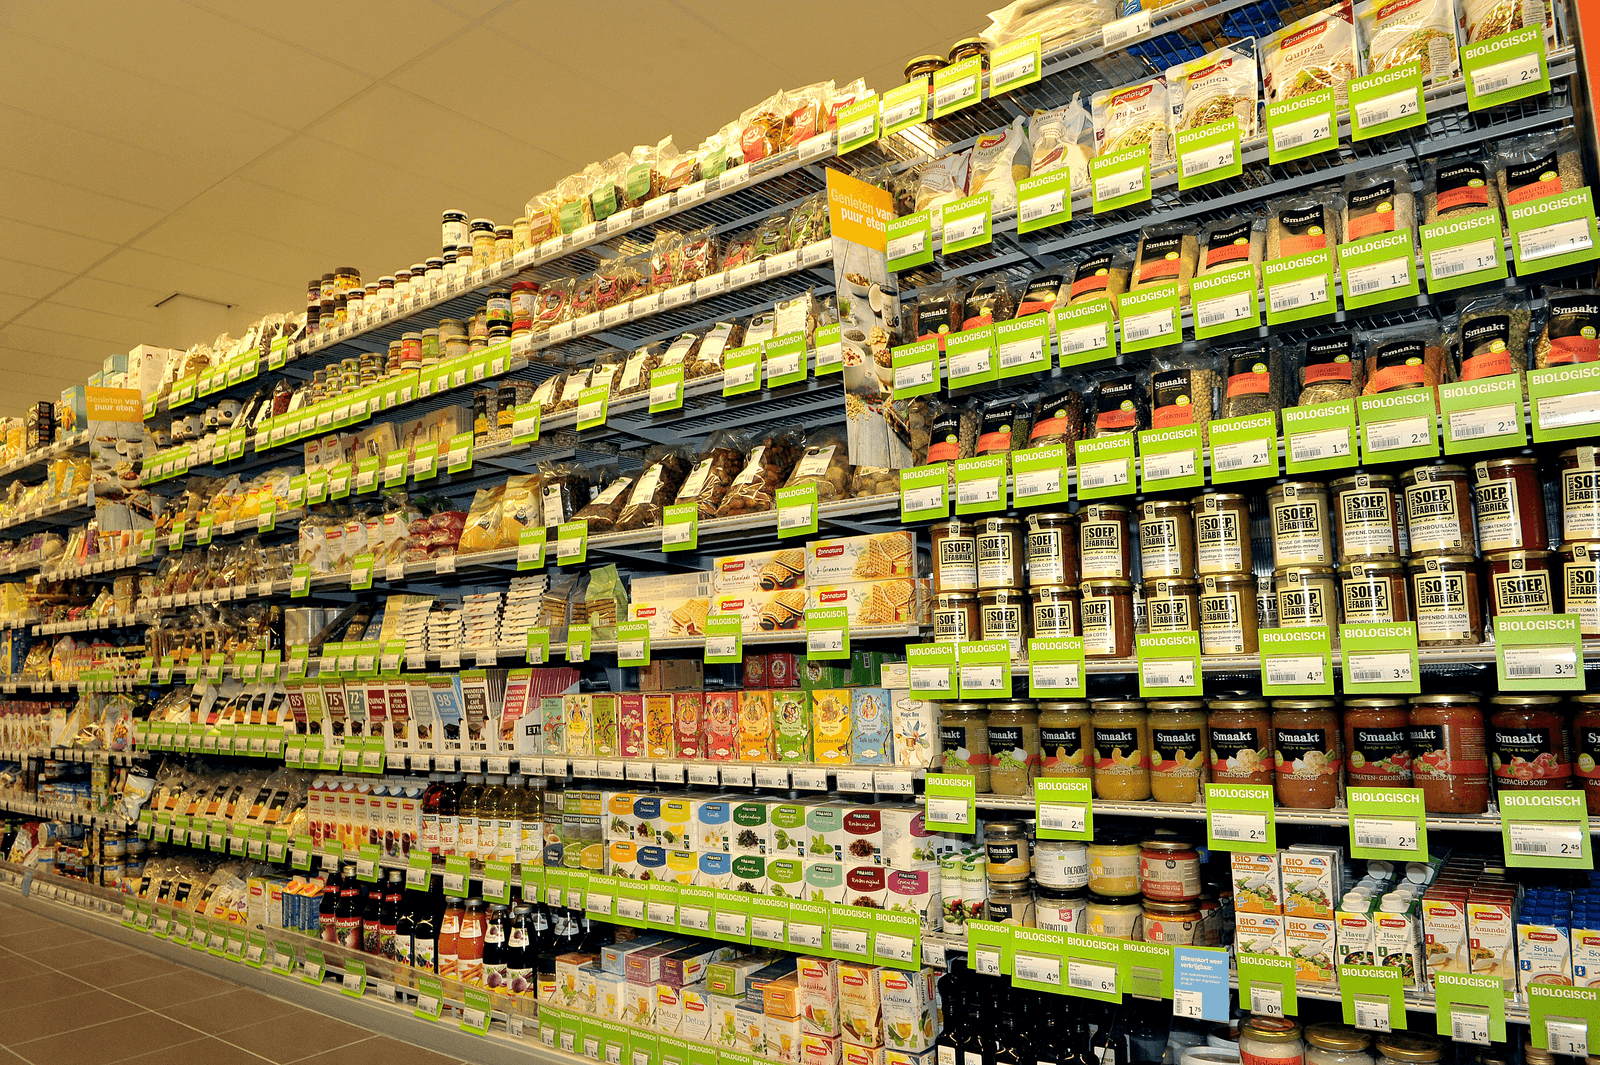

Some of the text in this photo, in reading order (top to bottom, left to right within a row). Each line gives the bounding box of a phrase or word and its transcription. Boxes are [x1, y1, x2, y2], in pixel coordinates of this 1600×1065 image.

[993, 36, 1038, 59] BIOLOGISCH
[1465, 30, 1538, 59] BIOLOGISCH
[936, 59, 979, 80] BIOLOGISCH
[1521, 67, 1539, 81] 2.69
[1351, 66, 1417, 93] BIOLOGISCH
[1270, 92, 1331, 117] BIOLOGISCH
[1400, 101, 1416, 114] 2.69
[1179, 122, 1235, 144] BIOLOGISCH
[1313, 127, 1328, 138] 2.69
[1094, 148, 1146, 170] BIOLOGISCH
[1440, 166, 1481, 179] Smaakt
[1020, 171, 1068, 191] BIOLOGISCH
[830, 188, 893, 221] Genieten van
[945, 196, 988, 214] BIOLOGISCH
[1512, 193, 1588, 220] BIOLOGISCH
[841, 208, 863, 224] puur
[1282, 211, 1320, 224] Smaakt
[888, 214, 928, 231] BIOLOGISCH
[1424, 214, 1495, 239] BIOLOGISCH
[1341, 234, 1407, 257] BIOLOGISCH
[1266, 253, 1328, 274] BIOLOGISCH
[1476, 254, 1494, 268] 1.59
[1029, 279, 1058, 290] Smaakt
[1193, 270, 1251, 291] BIOLOGISCH
[1121, 288, 1175, 306] BIOLOGISCH
[920, 308, 948, 318] Smaakt
[1058, 304, 1107, 320] BIOLOGISCH
[1552, 305, 1598, 316] Smaakt
[998, 317, 1045, 334] BIOLOGISCH
[1464, 323, 1505, 339] Smaakt
[767, 335, 803, 349] BIOLOGISCH
[1310, 341, 1348, 351] Smaakt
[727, 347, 759, 360] BIOLOGISCH
[894, 342, 935, 358] BIOLOGISCH
[1155, 377, 1188, 389] Smaakt
[1444, 380, 1516, 399] BIOLOGISCH
[1361, 392, 1430, 410] BIOLOGISCH
[1286, 405, 1350, 421] BIOLOGISCH
[1212, 417, 1271, 433] BIOLOGISCH
[1497, 420, 1515, 432] 2.19
[1142, 428, 1197, 443] BIOLOGISCH
[1078, 438, 1130, 453] BIOLOGISCH
[1015, 449, 1063, 462] BIOLOGISCH
[902, 467, 945, 481] BIOLOGISCH
[778, 487, 814, 499] BIOLOGISCH
[1415, 489, 1446, 503] SOEP
[1352, 494, 1382, 508] SOEP
[1283, 507, 1312, 520] SOEP
[1353, 506, 1386, 519] FABRIEK
[1416, 501, 1449, 515] FABRIEK
[1284, 520, 1314, 530] FABRIEK
[1425, 578, 1458, 593] SOEP
[1507, 577, 1541, 591] SOEP
[1426, 594, 1459, 605] FABRIEK
[1508, 592, 1545, 603] FABRIEK
[808, 611, 845, 620] BIOLOGISCH
[1499, 620, 1575, 631] BIOLOGISCH
[1263, 632, 1326, 642] BIOLOGISCH
[1344, 628, 1412, 638] BIOLOGISCH
[1032, 642, 1081, 650] BIOLOGISCH
[1140, 636, 1196, 647] BIOLOGISCH
[909, 647, 952, 656] BIOLOGISCH
[961, 644, 1007, 653] BIOLOGISCH
[1394, 669, 1409, 678] 3.65
[1555, 664, 1573, 674] 3.59
[1042, 731, 1076, 739] Smaakt
[1096, 731, 1132, 742] Smaakt
[1157, 733, 1196, 742] Smaakt
[1213, 731, 1252, 740] Smaakt
[1278, 732, 1320, 742] Smaakt
[1359, 731, 1404, 742] Smaakt
[1496, 733, 1542, 744] Smaakt
[928, 778, 972, 787] BIOLOGISCH
[1038, 782, 1088, 791] BIOLOGISCH
[1209, 789, 1269, 799] BIOLOGISCH
[1352, 793, 1420, 803] BIOLOGISCH
[1504, 796, 1581, 806] BIOLOGISCH
[1561, 844, 1579, 854] 2.45
[1286, 858, 1303, 866] BIO
[1284, 866, 1304, 874] Avena
[681, 888, 714, 898] BIOLOGISCH
[717, 892, 749, 903] BIOLOGISCH
[832, 908, 871, 919] BIOLOGISCH
[876, 914, 917, 925] BIOLOGISCH
[970, 922, 1009, 934] BIOLOGISCH
[1473, 926, 1507, 934] Amandel
[1015, 931, 1063, 944] BIOLOGISCH
[1068, 937, 1118, 952] BIOLOGISCH
[1124, 944, 1170, 955] BIOLOGISCH
[1534, 945, 1553, 954] Soja
[1240, 956, 1291, 968] BIOLOGISCH
[1342, 968, 1398, 978] BIOLOGISCH
[1438, 976, 1499, 989] BIOLOGISCH
[1532, 987, 1597, 1000] BIOLOGISCH
[659, 1009, 678, 1019] Detox
[685, 1015, 705, 1026] Detox
[721, 1051, 750, 1063] BIOLOGISCH
